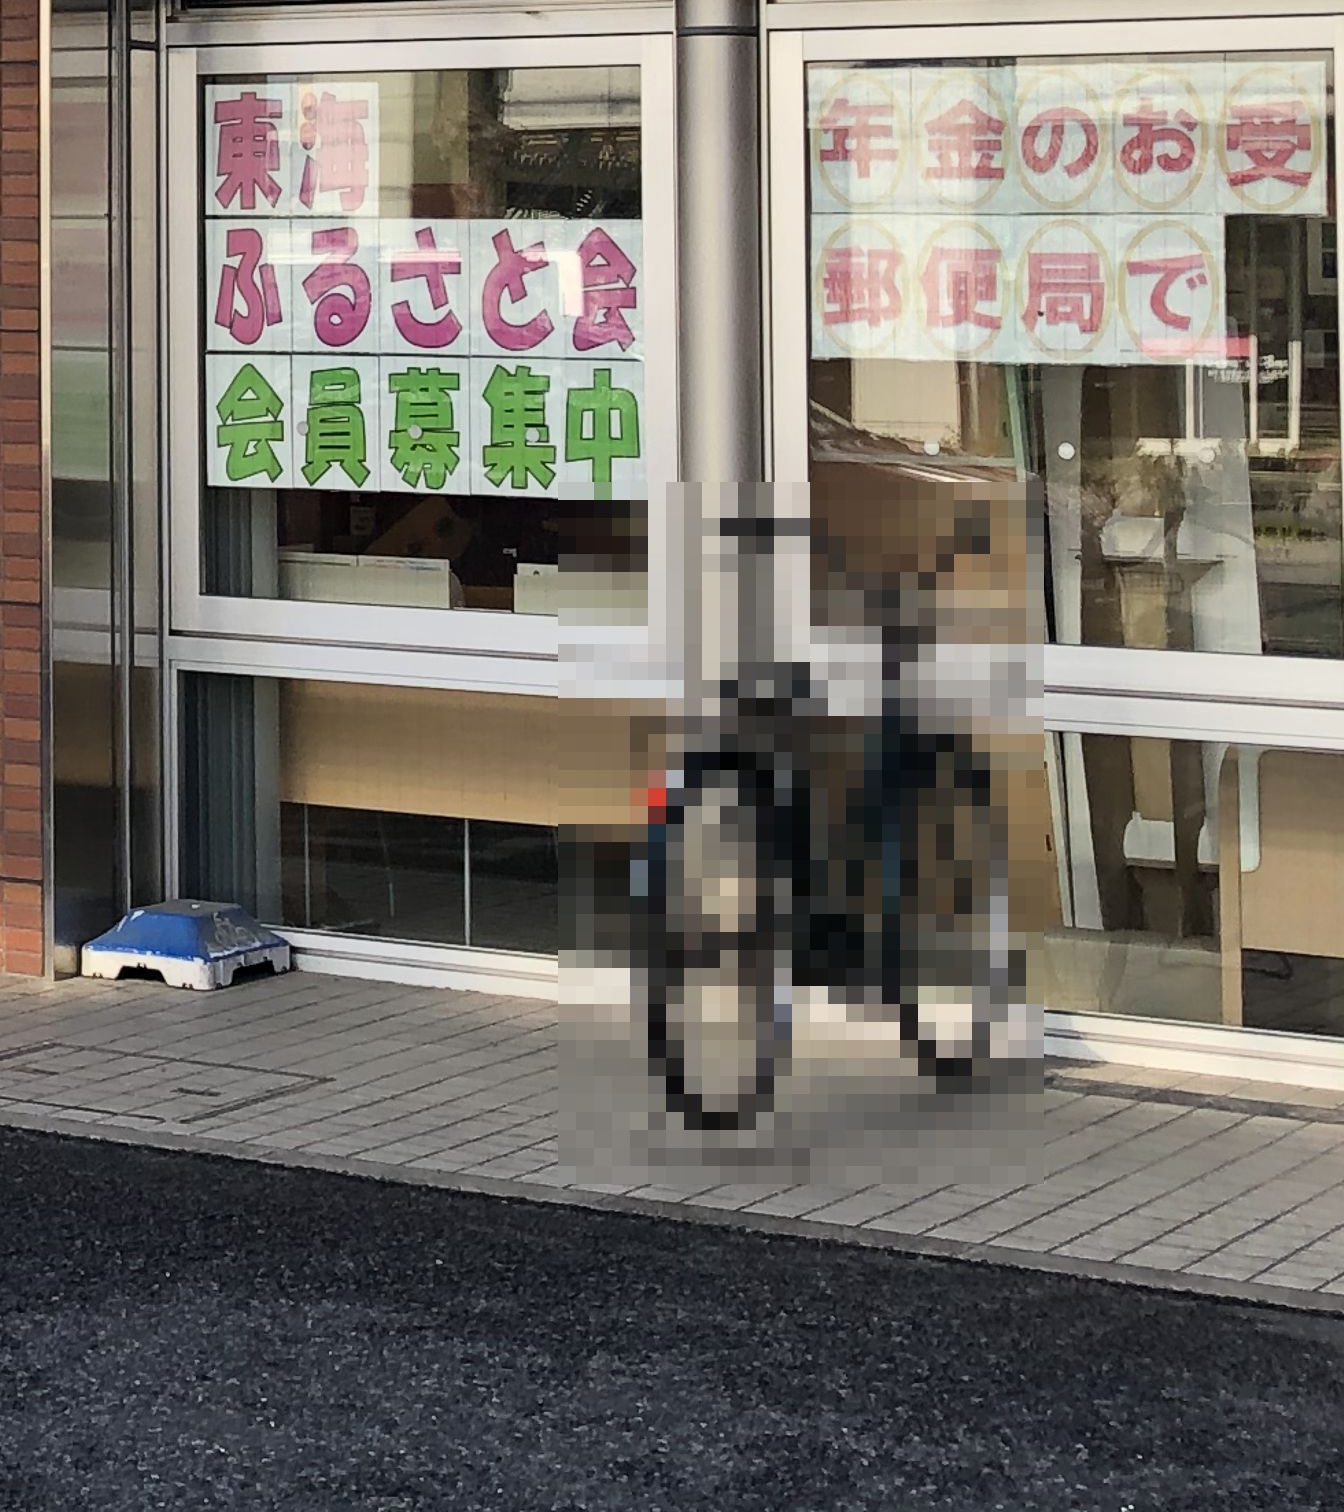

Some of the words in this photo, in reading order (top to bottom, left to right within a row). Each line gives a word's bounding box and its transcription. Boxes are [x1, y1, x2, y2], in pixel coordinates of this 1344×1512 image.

[215, 92, 370, 211] 東海
[819, 97, 1312, 188] 年金のお受
[215, 226, 637, 352] ふるさと会
[823, 247, 1209, 334] 郵便局で
[216, 363, 640, 492] 会員募集中
